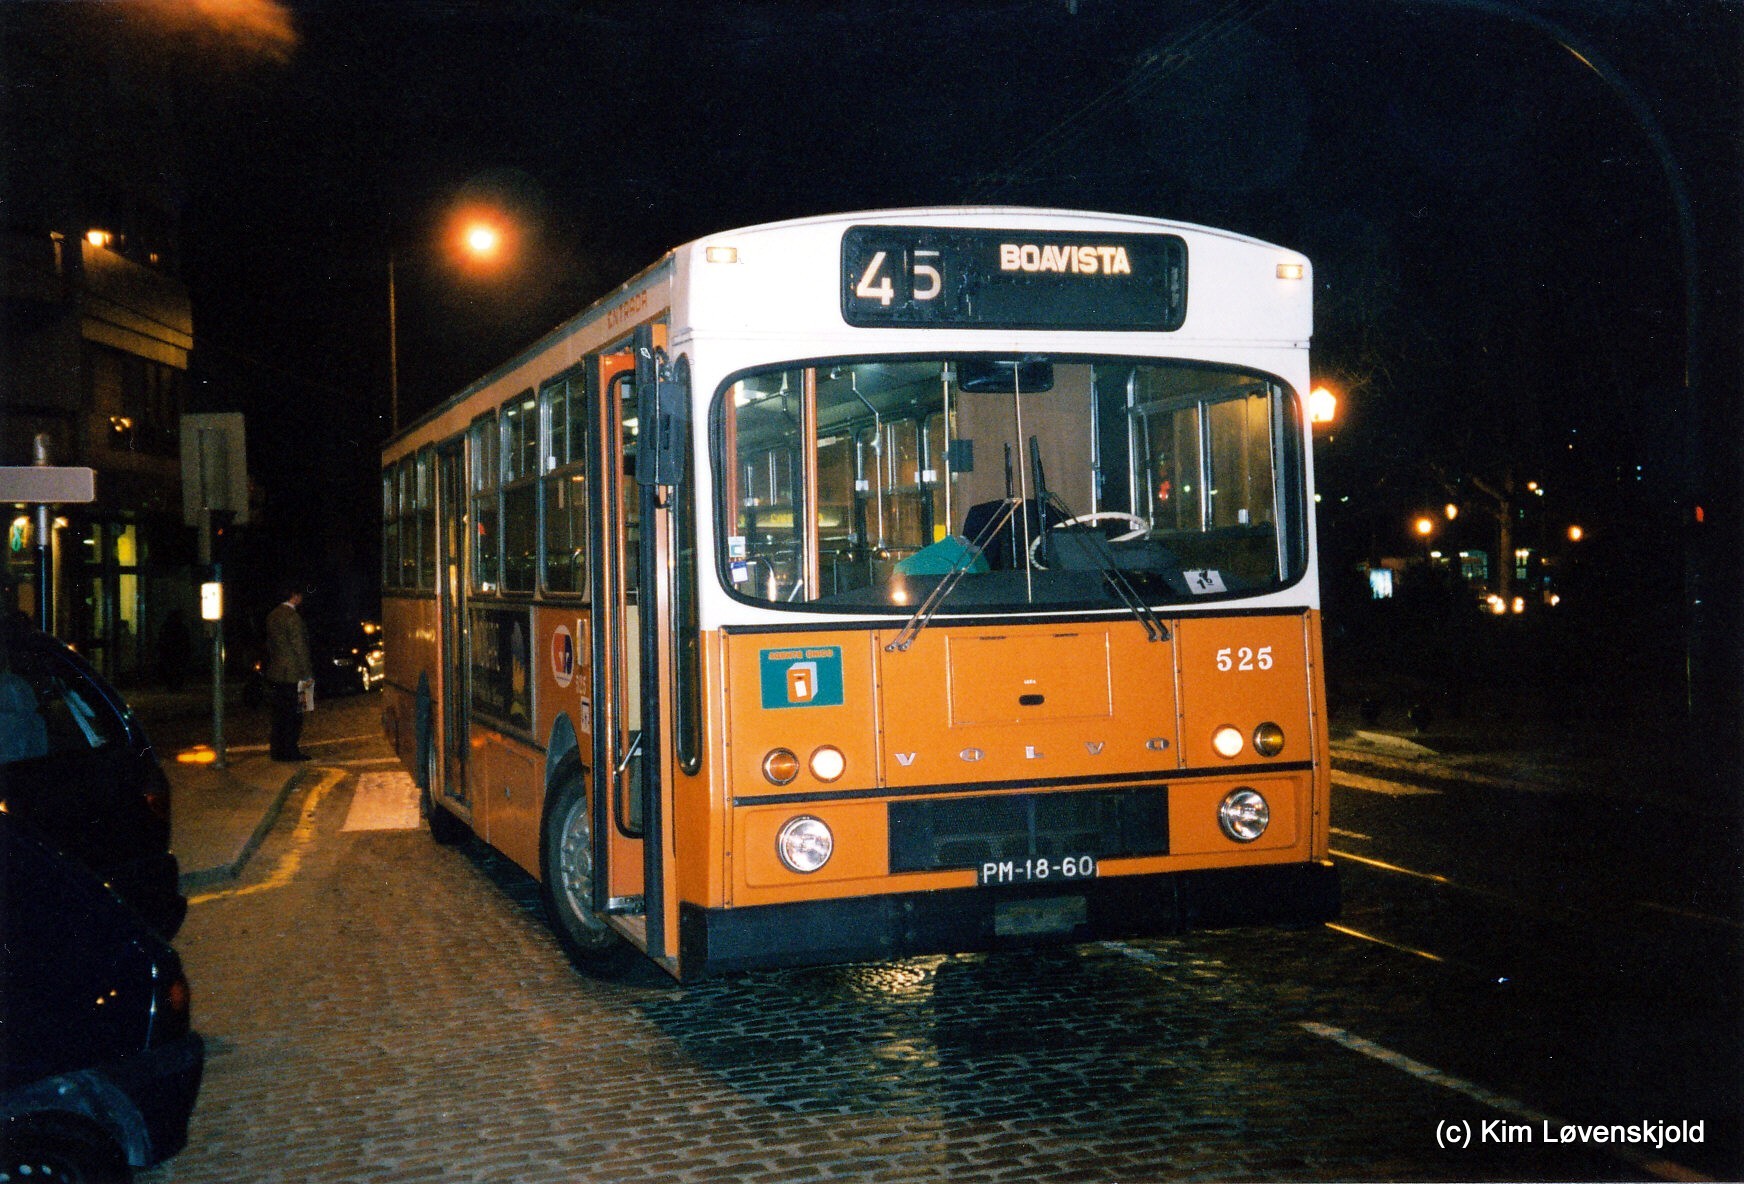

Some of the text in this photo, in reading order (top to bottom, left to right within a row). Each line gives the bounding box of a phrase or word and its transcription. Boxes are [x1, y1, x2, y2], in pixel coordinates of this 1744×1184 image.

[1000, 244, 1131, 274] BOAVISTA
[1216, 645, 1273, 672] 525
[895, 737, 1170, 766] VOLVO
[983, 856, 1093, 884] PM-18-60
